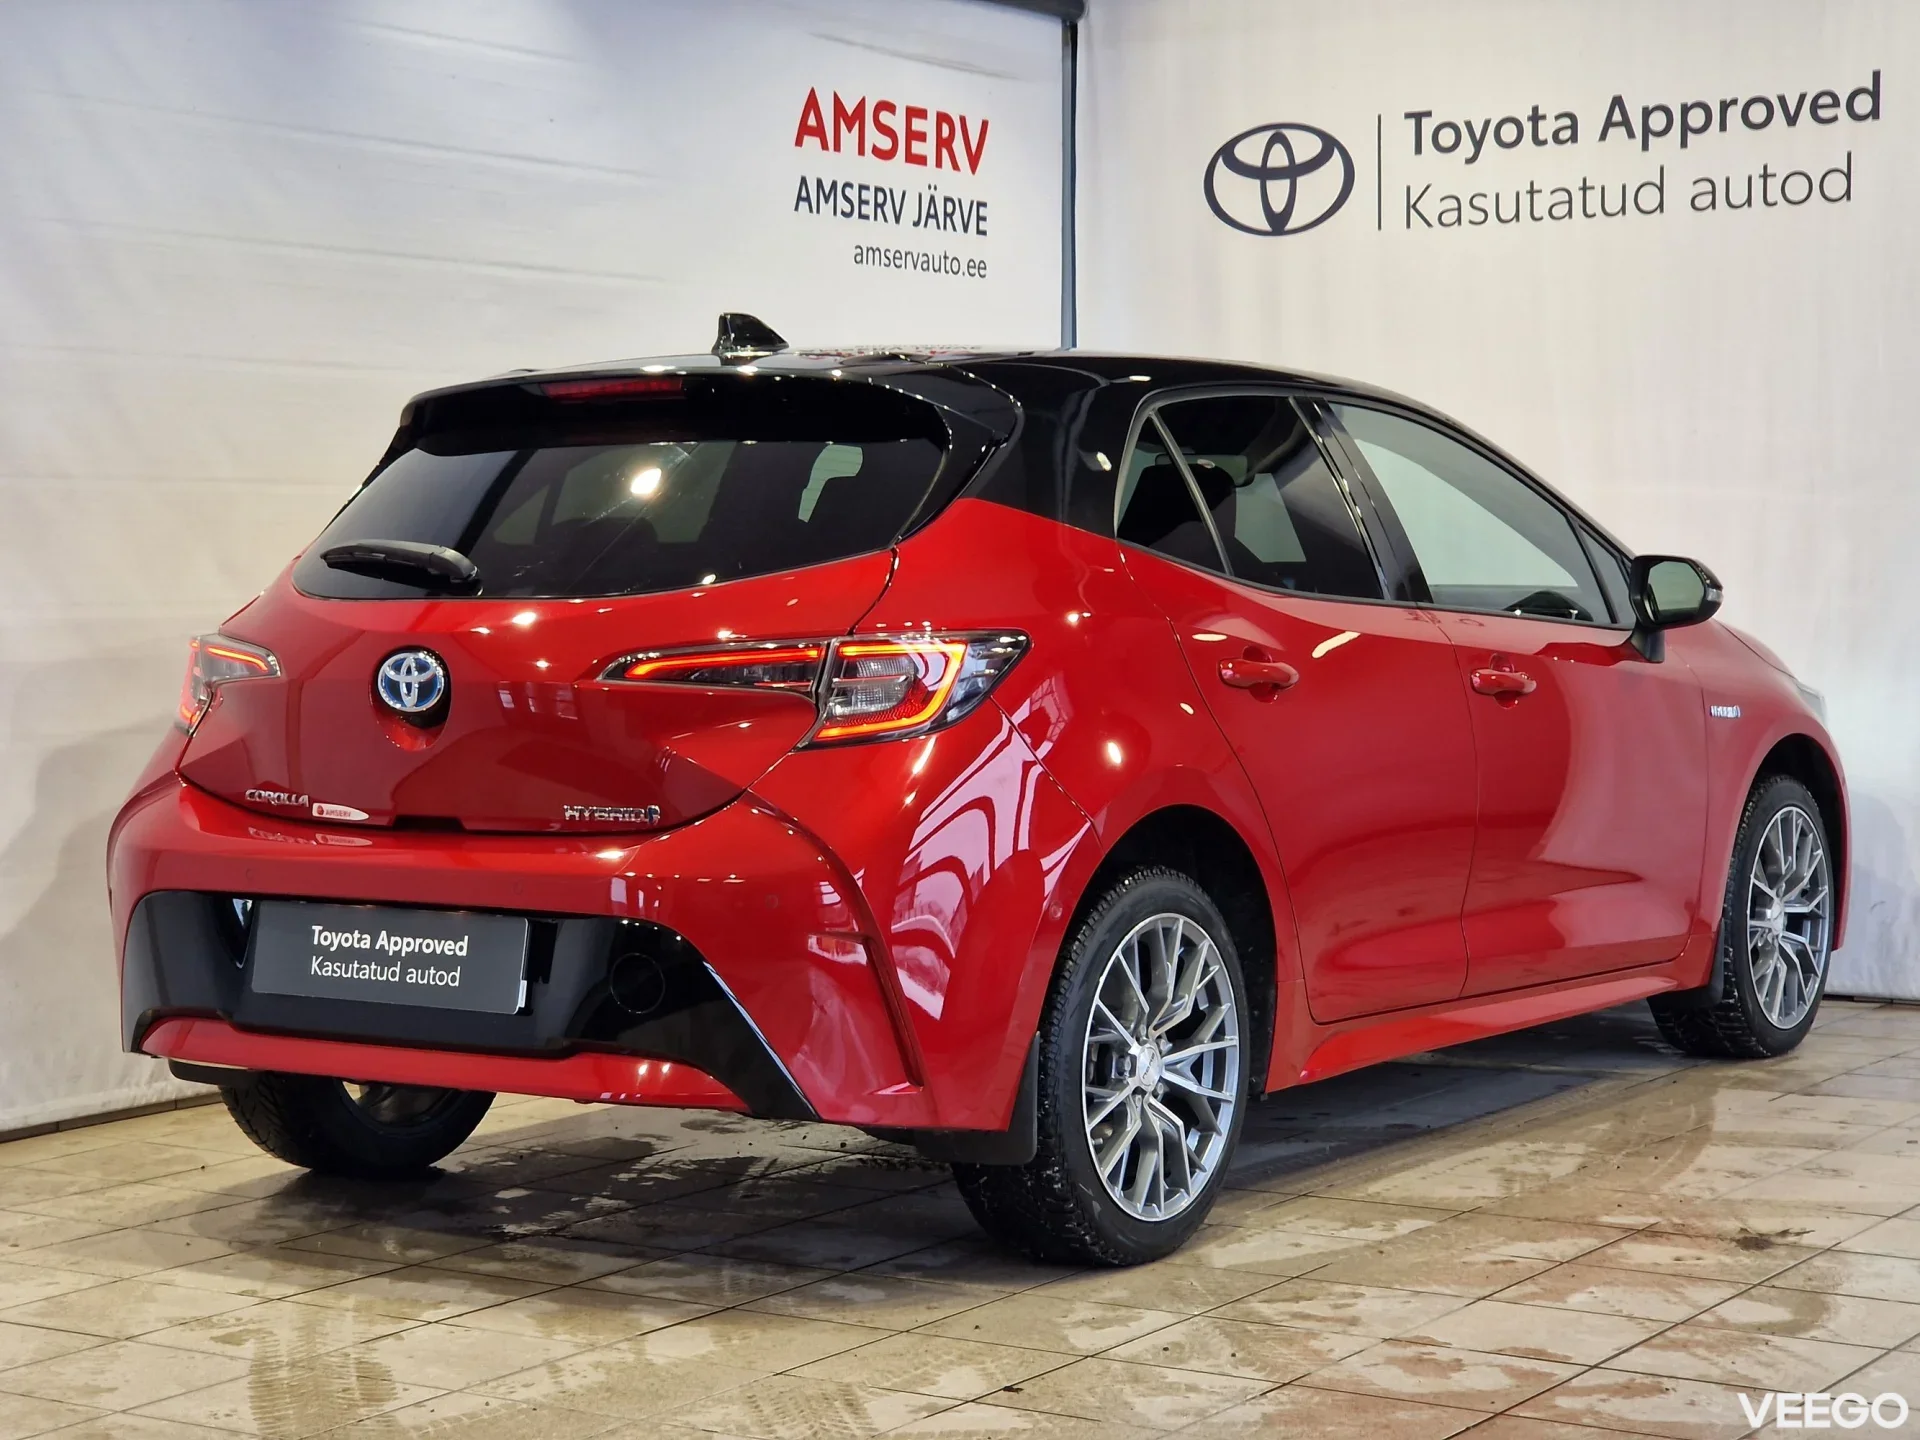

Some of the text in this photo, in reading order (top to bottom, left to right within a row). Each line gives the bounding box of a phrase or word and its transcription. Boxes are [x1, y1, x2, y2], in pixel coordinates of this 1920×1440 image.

[794, 86, 989, 176] AMSERV
[1403, 69, 1881, 165] Toyota Approved
[794, 174, 988, 237] AMSERV JÄRVE
[1404, 150, 1852, 229] Kasutatud autod
[853, 243, 988, 279] amservauto.ee
[245, 789, 310, 808] COROLLA
[325, 808, 352, 818] AMSERV
[563, 805, 645, 822] HYBRID
[311, 925, 469, 957] Toyota Approved
[310, 955, 461, 987] Kasutatud autod
